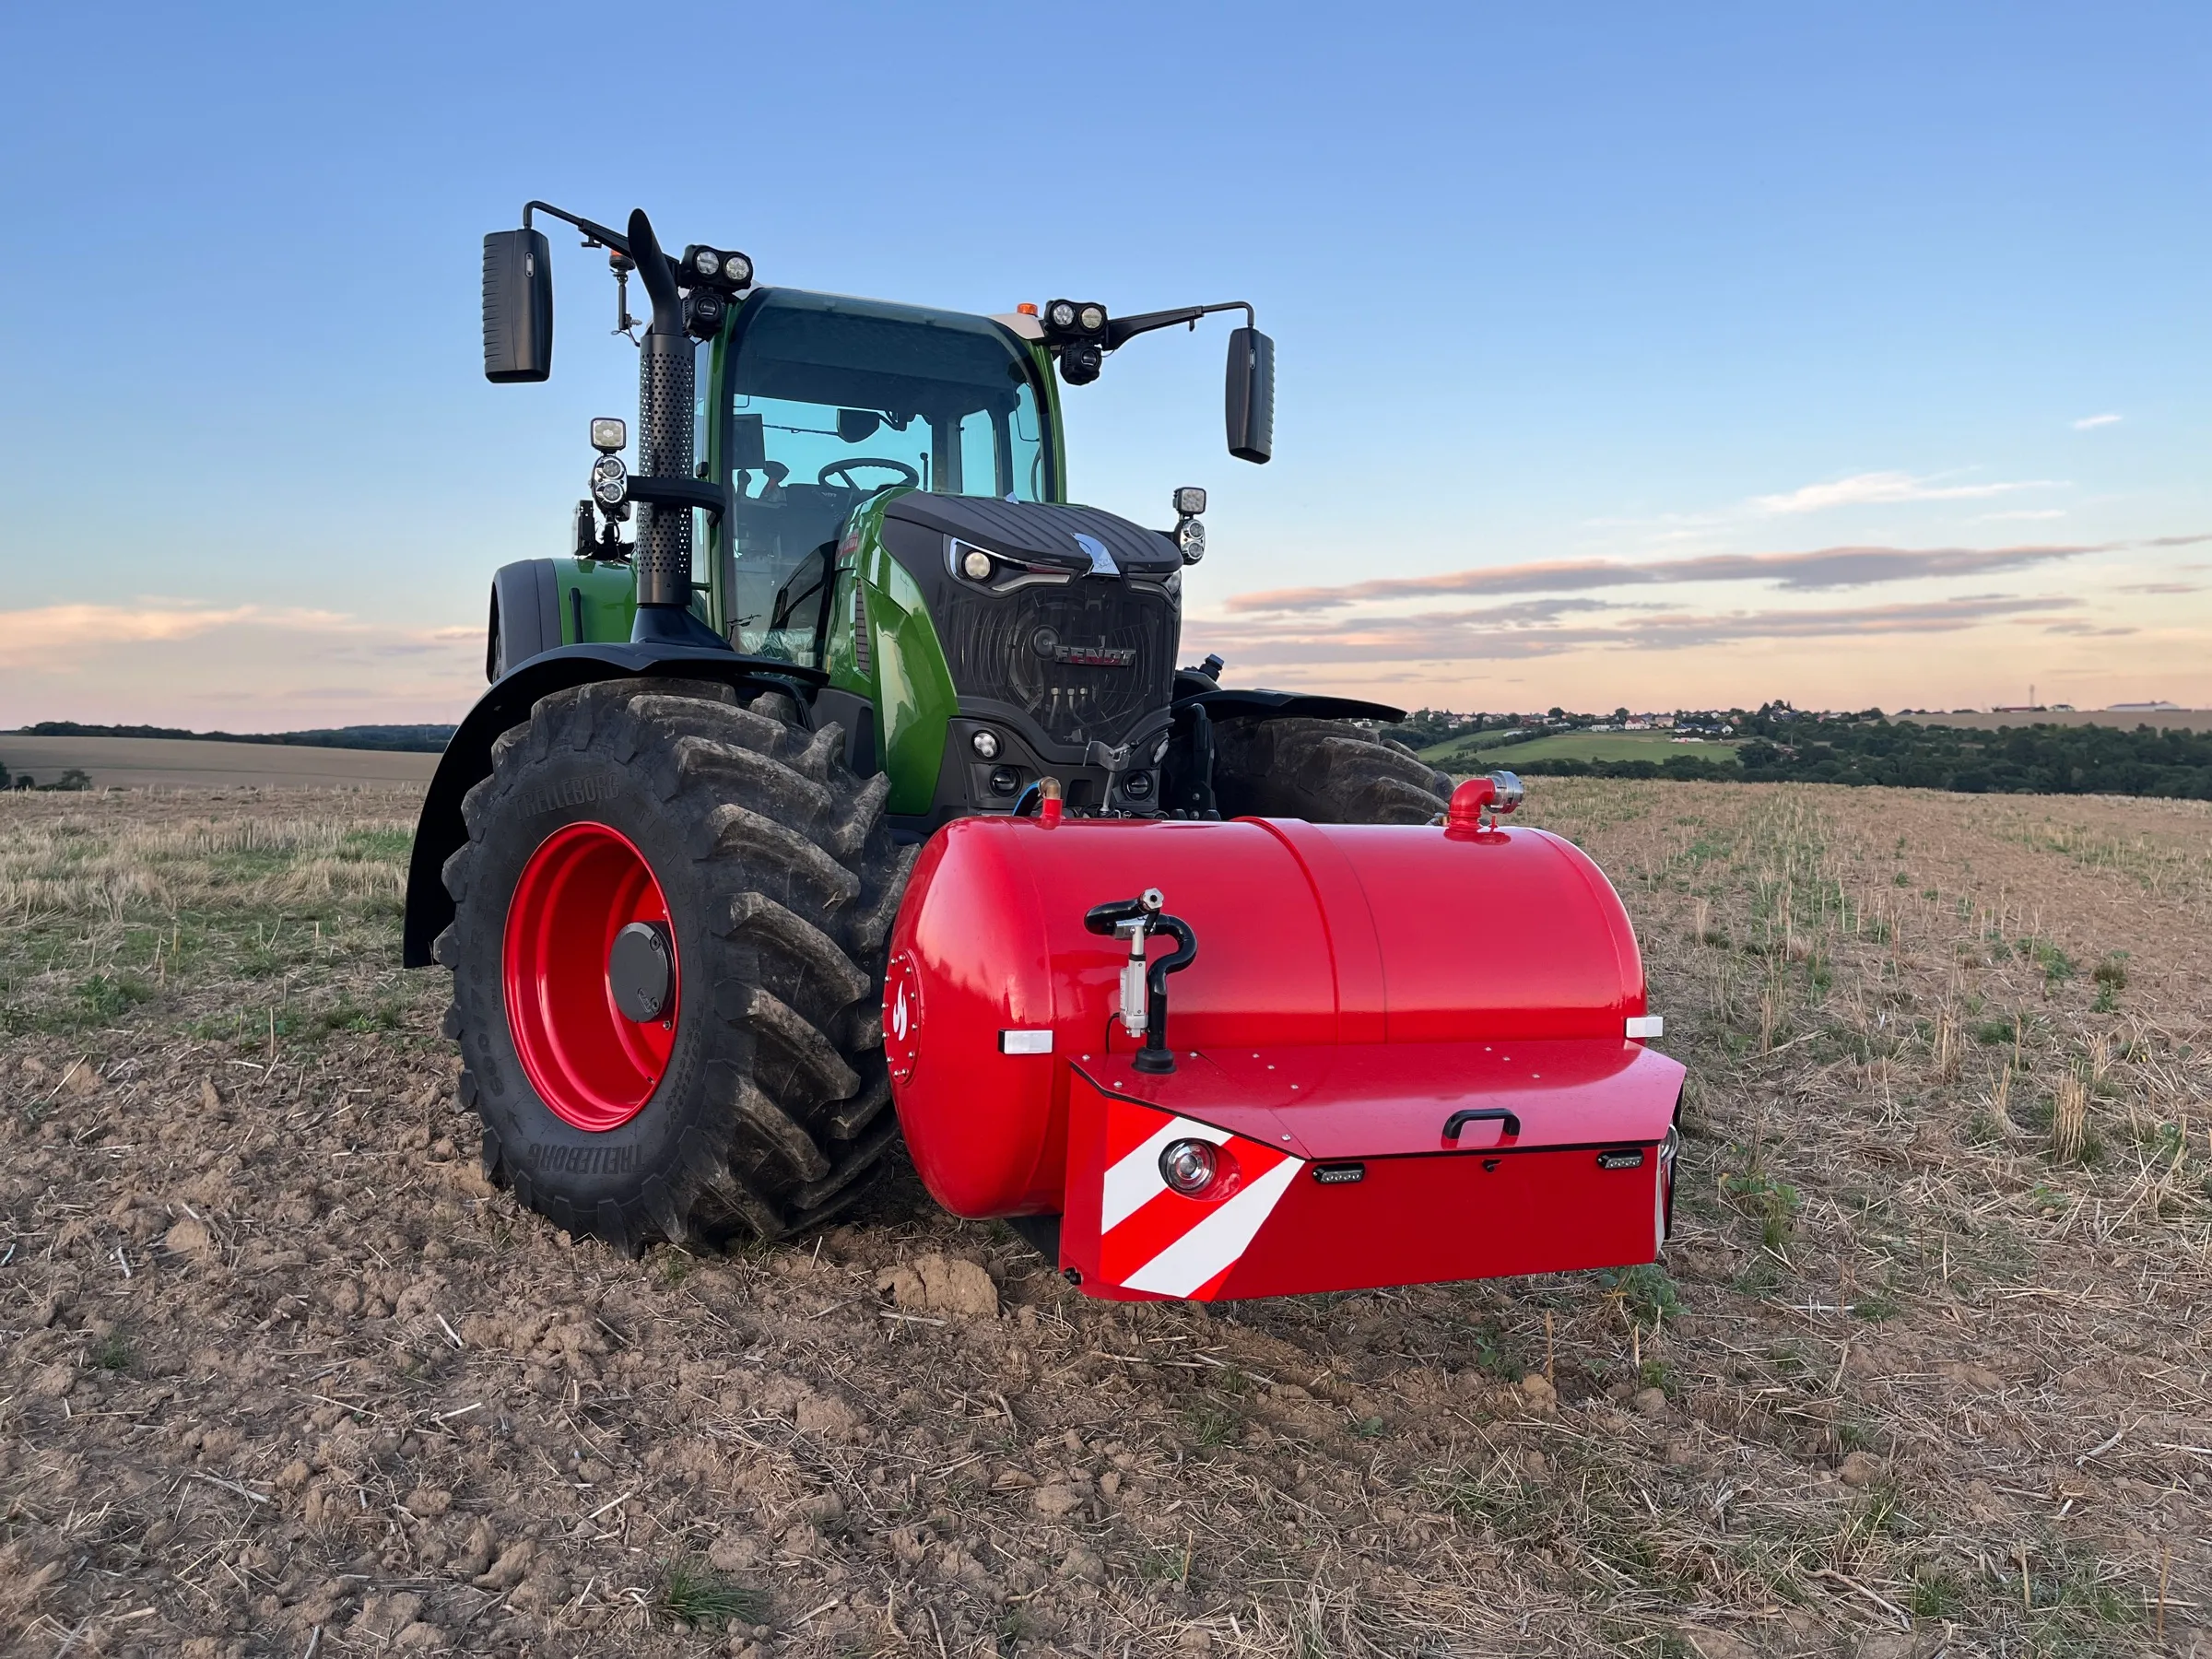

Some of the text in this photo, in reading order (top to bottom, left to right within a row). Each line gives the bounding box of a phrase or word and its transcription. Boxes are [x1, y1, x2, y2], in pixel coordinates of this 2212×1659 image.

[1052, 643, 1137, 667] FENDT
[512, 771, 621, 821] TRELLEBORG
[527, 1141, 646, 1175] TRELLEBORG
